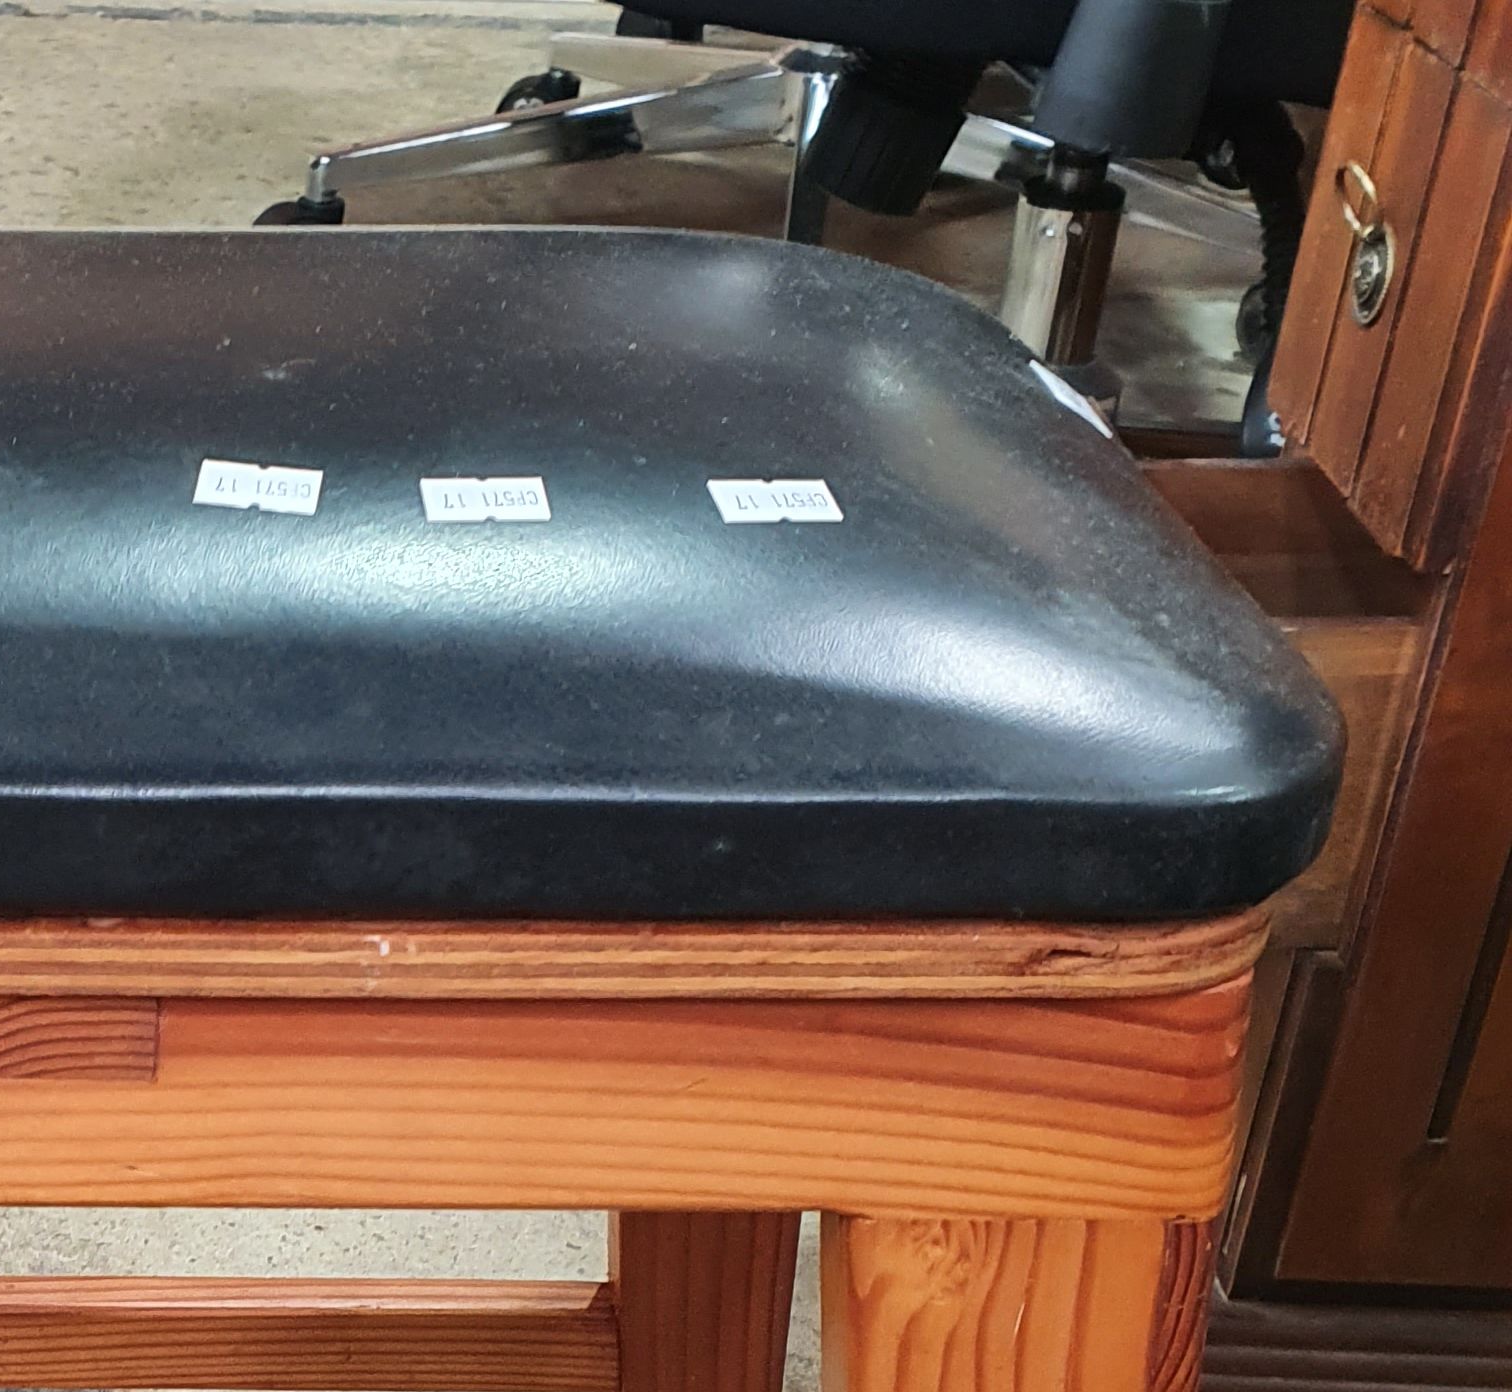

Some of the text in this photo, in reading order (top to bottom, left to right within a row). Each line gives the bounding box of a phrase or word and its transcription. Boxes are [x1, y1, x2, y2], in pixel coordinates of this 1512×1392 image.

[215, 476, 238, 493] 17
[443, 493, 467, 509] 17
[735, 494, 759, 510] 17
